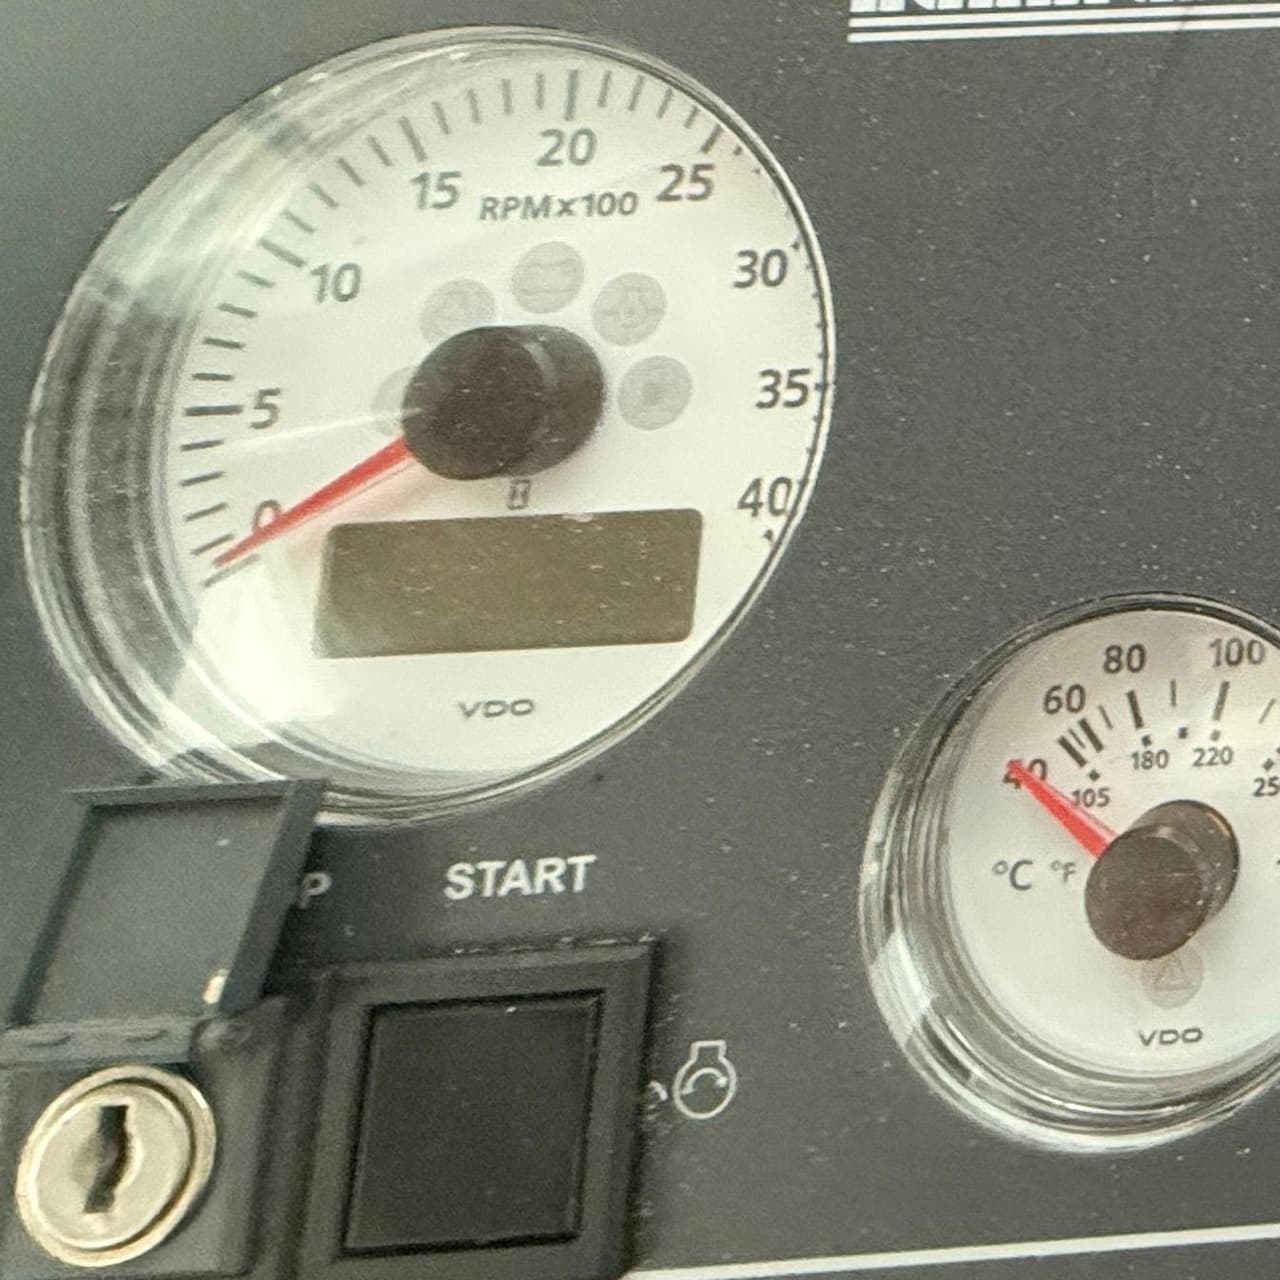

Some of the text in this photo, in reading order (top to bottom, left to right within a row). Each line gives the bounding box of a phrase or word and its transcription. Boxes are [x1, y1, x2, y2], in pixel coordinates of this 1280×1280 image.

[535, 127, 598, 167] 20
[410, 170, 462, 211] 15
[655, 163, 716, 202] 25
[310, 263, 362, 304] 10
[733, 249, 789, 289] 30
[249, 389, 282, 430] 5
[755, 371, 811, 410] 35
[737, 477, 793, 517] 40
[1102, 643, 1147, 673] 80
[1208, 637, 1266, 669] 100
[458, 698, 536, 719] VDO
[1043, 683, 1087, 715] 60
[1130, 747, 1170, 770] 180
[1191, 745, 1234, 768] 220
[1071, 786, 1111, 809] 105
[444, 853, 598, 901] START
[1136, 1027, 1204, 1047] VDO
